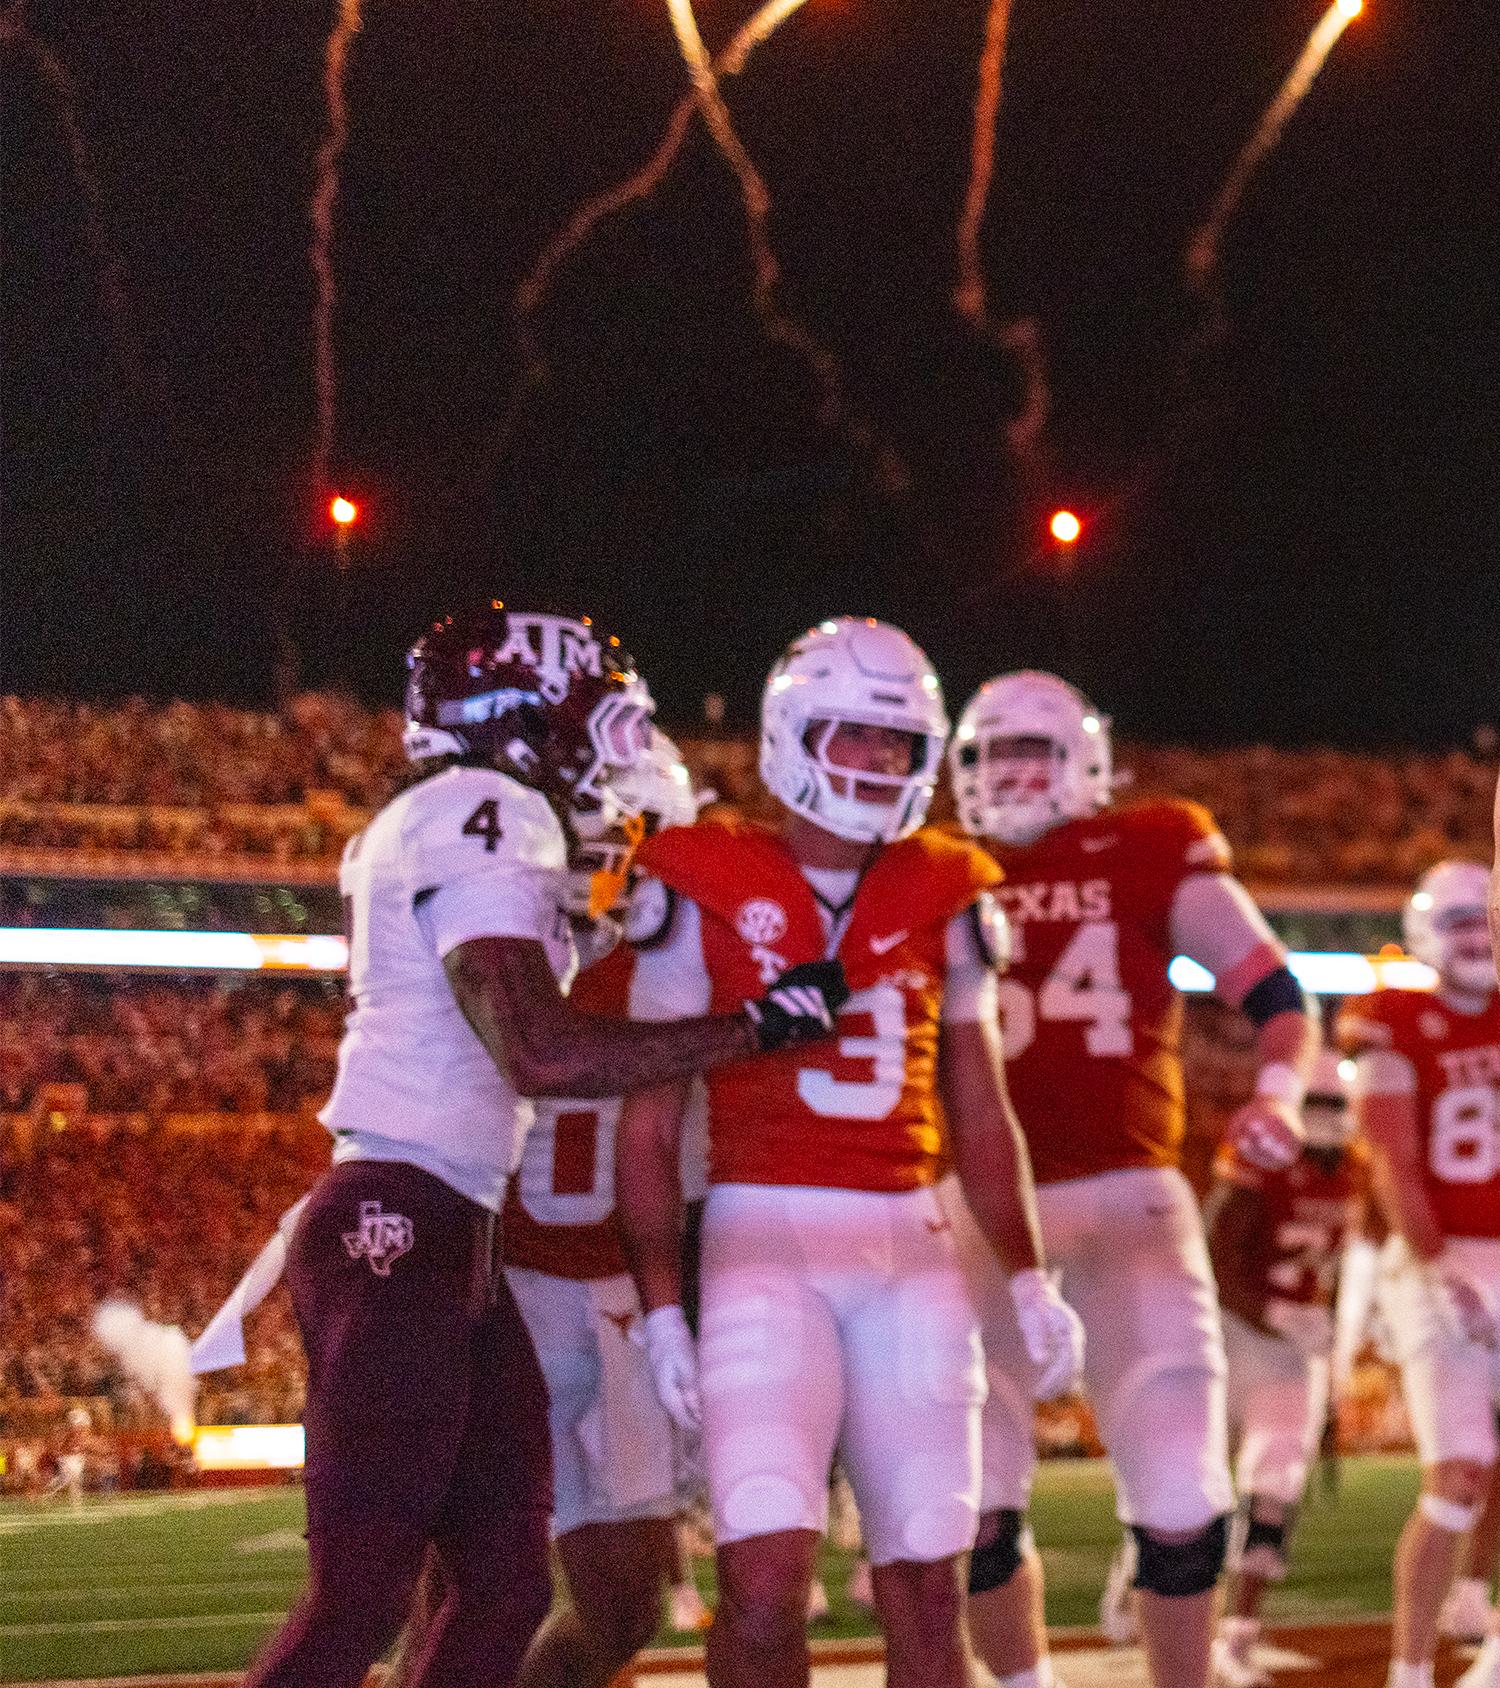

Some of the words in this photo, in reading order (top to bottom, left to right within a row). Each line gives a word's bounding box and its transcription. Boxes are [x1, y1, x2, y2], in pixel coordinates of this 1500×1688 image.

[462, 798, 502, 852] 4
[797, 984, 906, 1119] 3
[519, 1097, 622, 1224] 0
